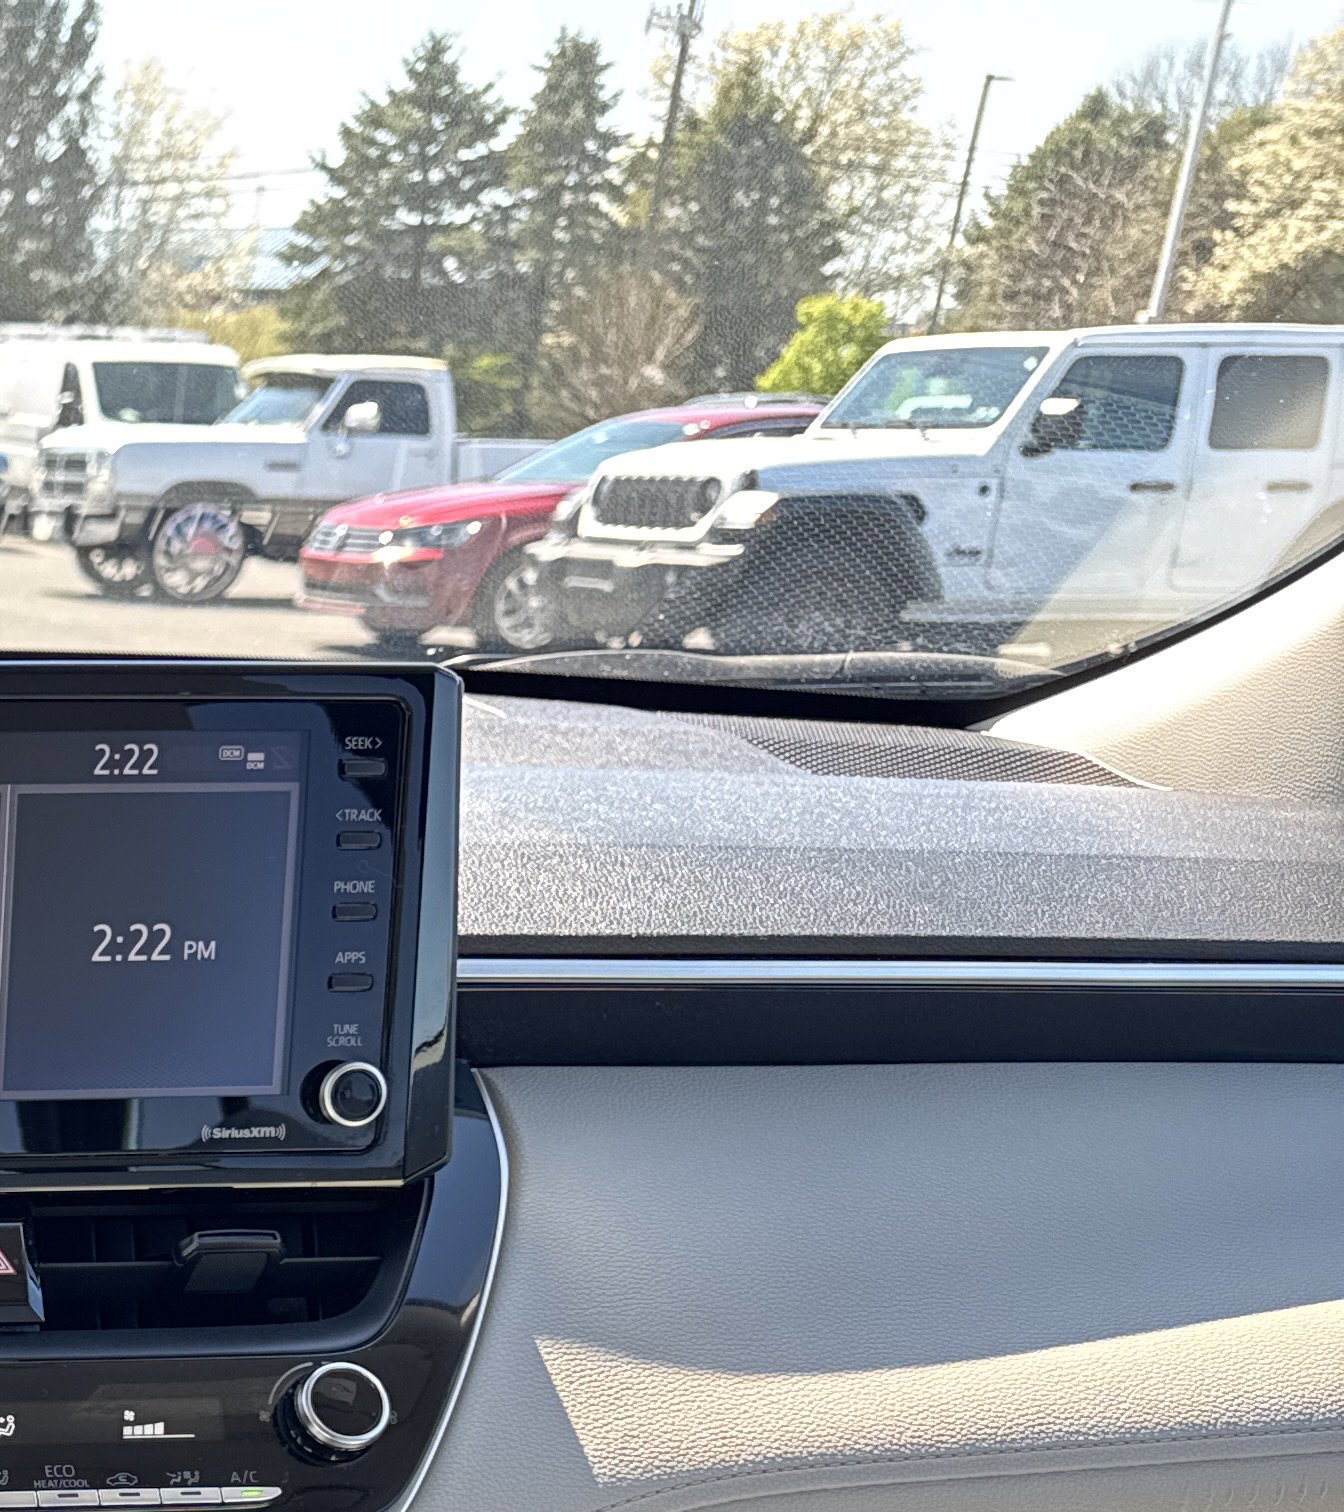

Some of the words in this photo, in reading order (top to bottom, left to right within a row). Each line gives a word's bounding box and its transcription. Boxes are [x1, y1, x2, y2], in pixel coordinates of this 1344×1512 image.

[93, 743, 159, 775] 2:22
[222, 750, 241, 758] DCM
[246, 762, 265, 770] DCM
[333, 880, 376, 894] PHONE
[90, 922, 172, 962] 2:22
[183, 940, 216, 961] PM
[334, 951, 366, 964] APPS
[333, 1023, 359, 1035] TUNE
[327, 1036, 363, 1048] SCROLL
[44, 1464, 76, 1478] ECO
[230, 1470, 259, 1484] A/C
[33, 1479, 90, 1489] HEAT/COOL
